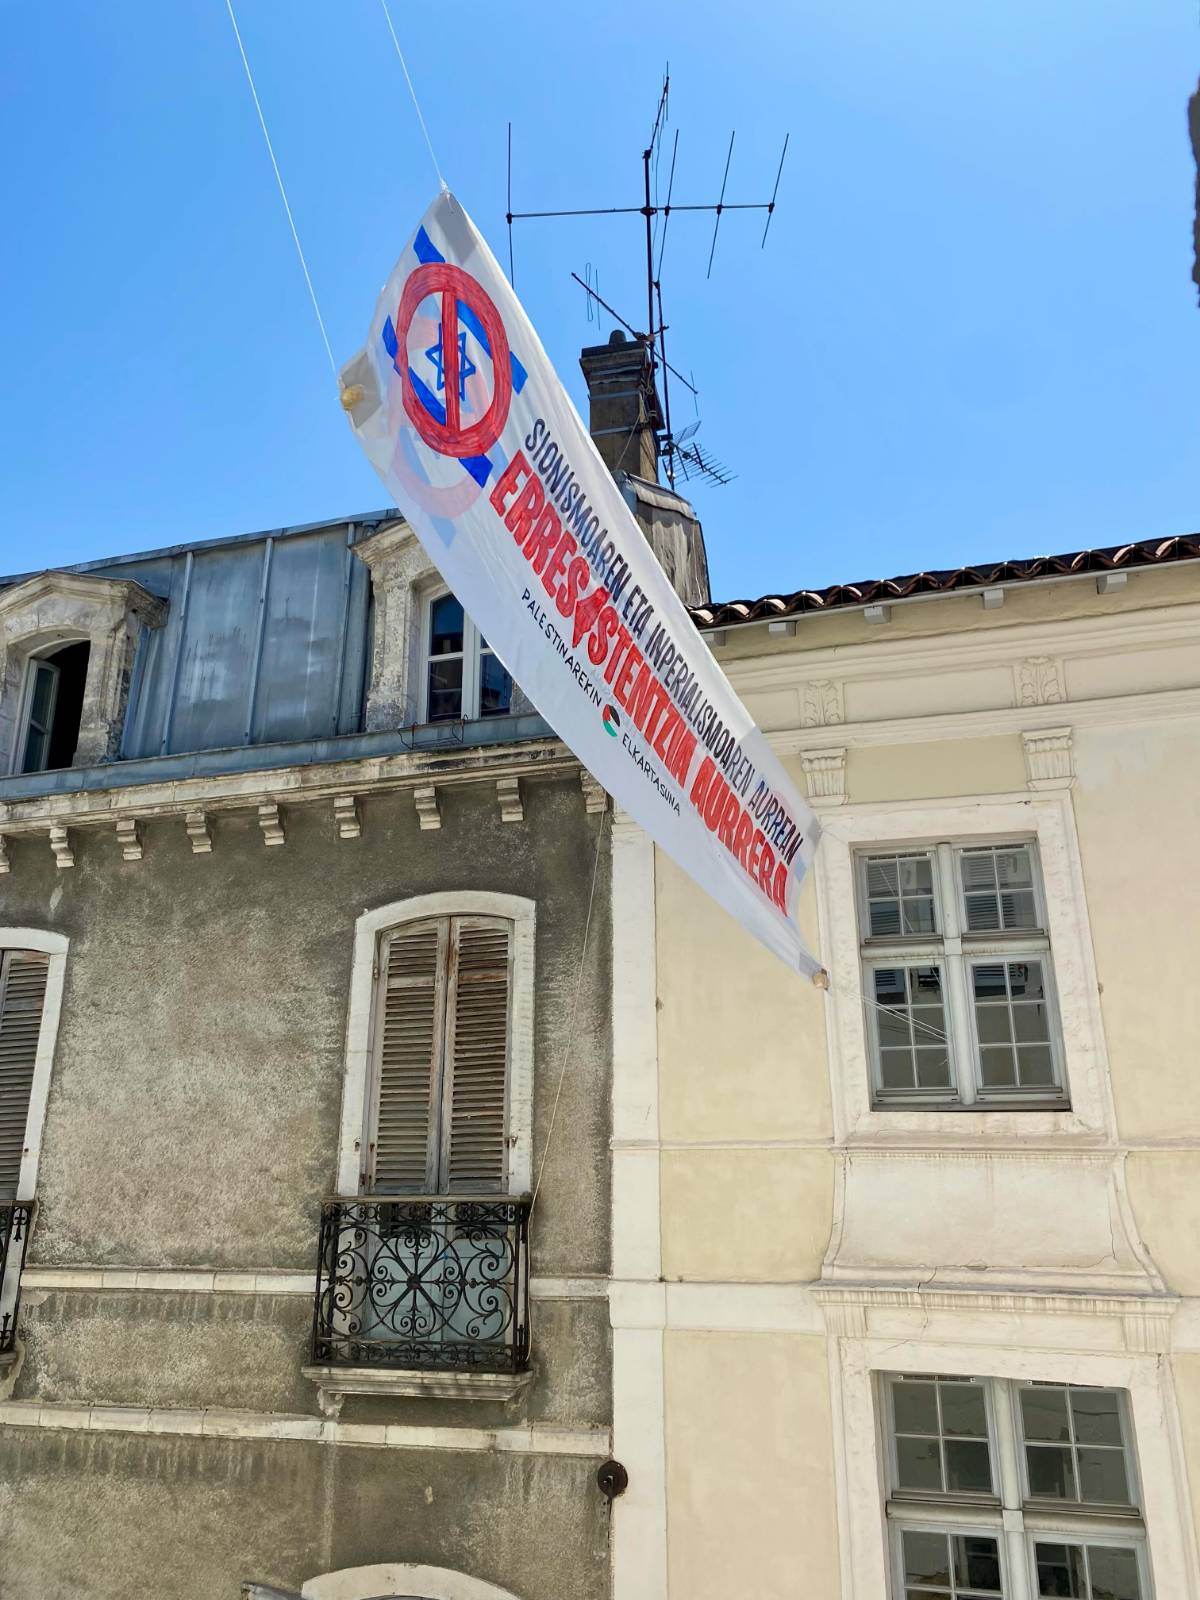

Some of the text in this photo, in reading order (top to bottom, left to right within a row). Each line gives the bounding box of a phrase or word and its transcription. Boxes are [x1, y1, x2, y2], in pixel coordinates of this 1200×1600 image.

[522, 588, 680, 816] PALESTINAREKIN ELKARTASUNA
[525, 418, 803, 866] SIONISMOAREN ETA INPERIALISMOAREN AURREAN
[690, 755, 788, 917] AURRERA
